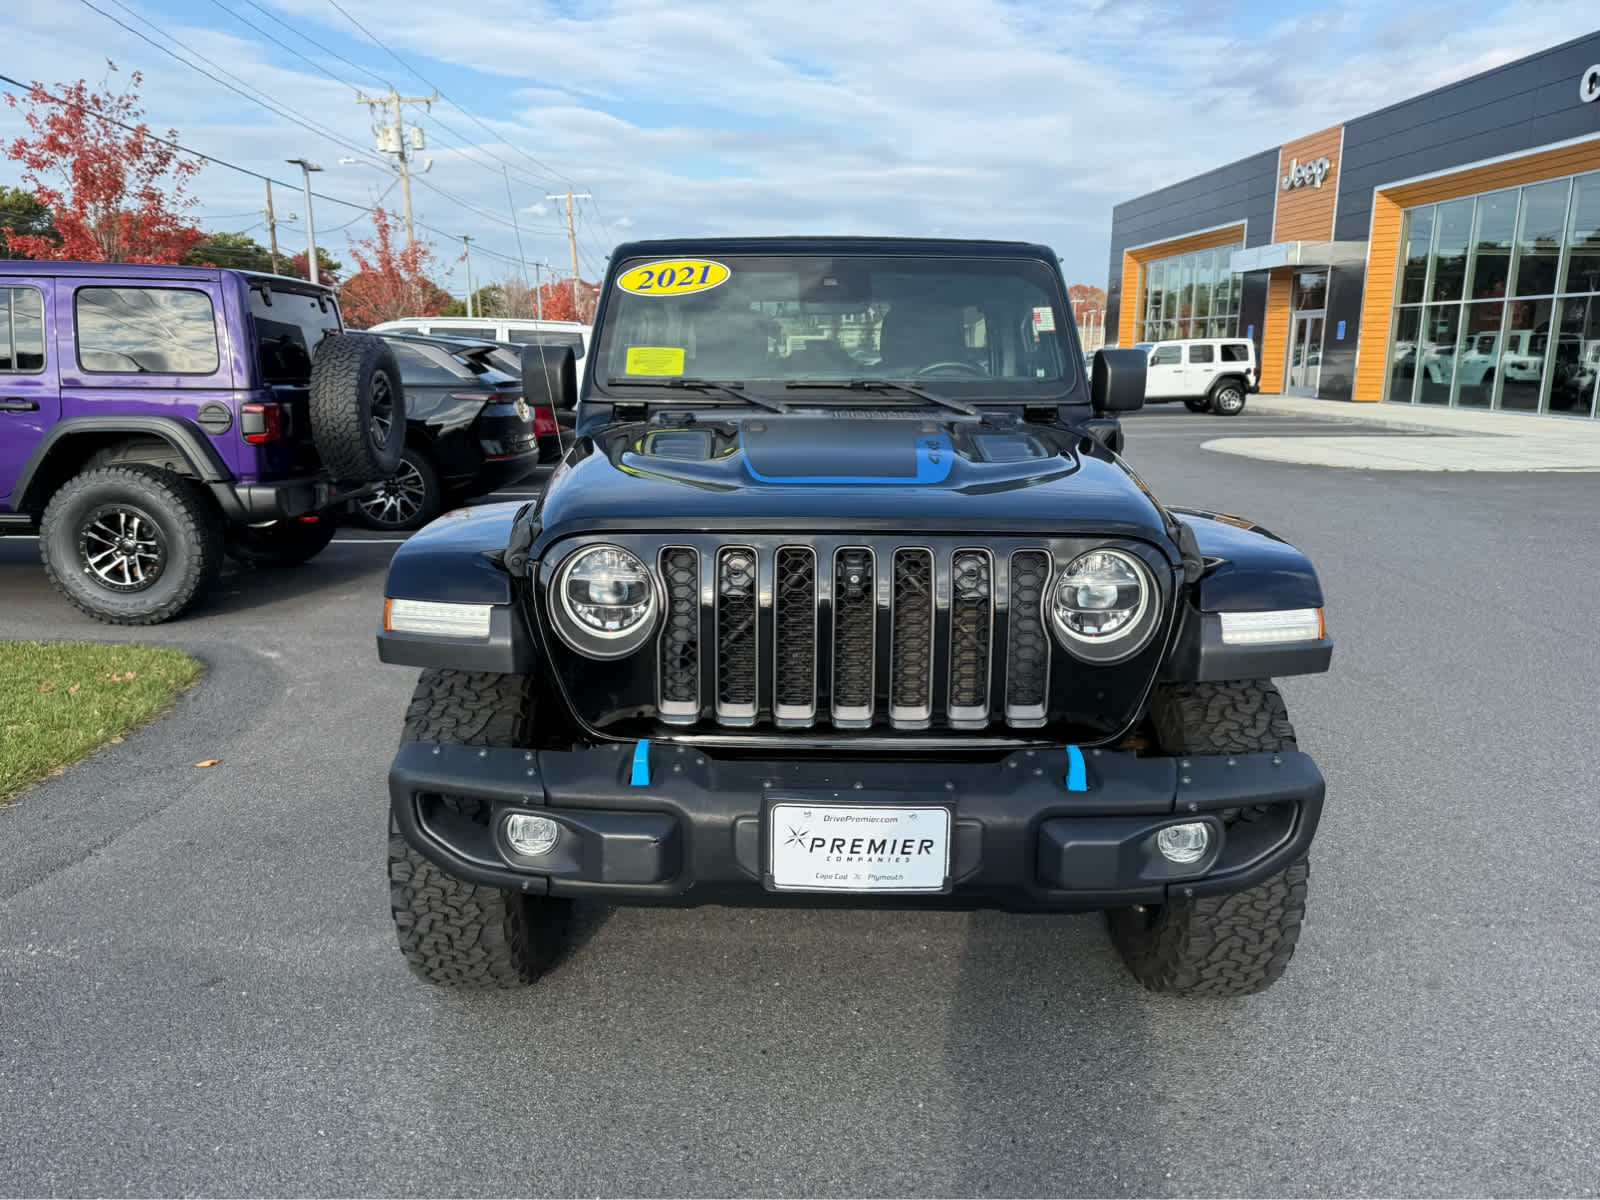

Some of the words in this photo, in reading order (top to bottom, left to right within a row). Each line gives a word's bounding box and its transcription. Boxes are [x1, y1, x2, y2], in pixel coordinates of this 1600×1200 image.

[1281, 157, 1330, 190] Jeep
[636, 265, 711, 291] 2021
[823, 814, 898, 824] DrivePremier.com
[809, 837, 934, 856] PREMIER
[815, 872, 834, 881] Cape
[835, 873, 848, 881] Cod
[867, 873, 904, 882] Plymouth
